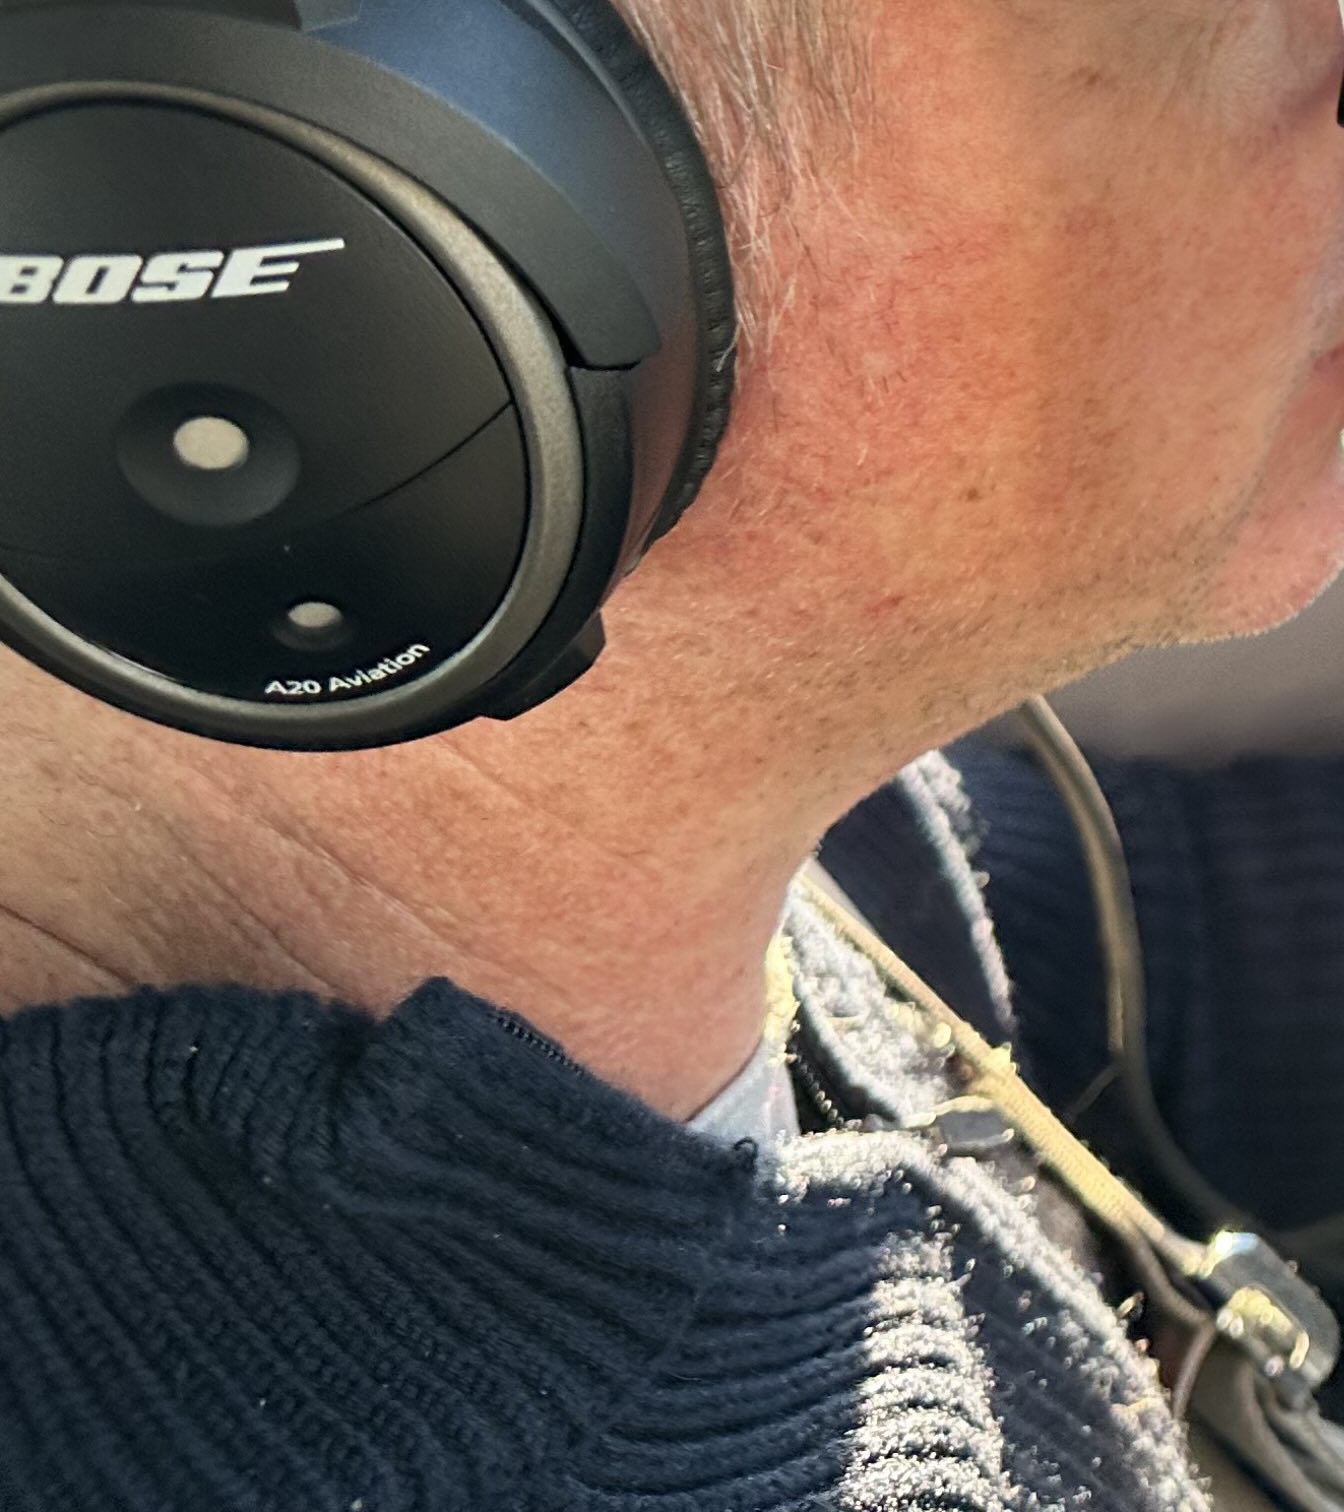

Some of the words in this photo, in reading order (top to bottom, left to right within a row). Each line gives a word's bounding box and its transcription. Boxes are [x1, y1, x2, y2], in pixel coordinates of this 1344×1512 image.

[0, 238, 346, 304] BOSE
[264, 679, 322, 696] A20
[328, 643, 431, 692] Aviation
